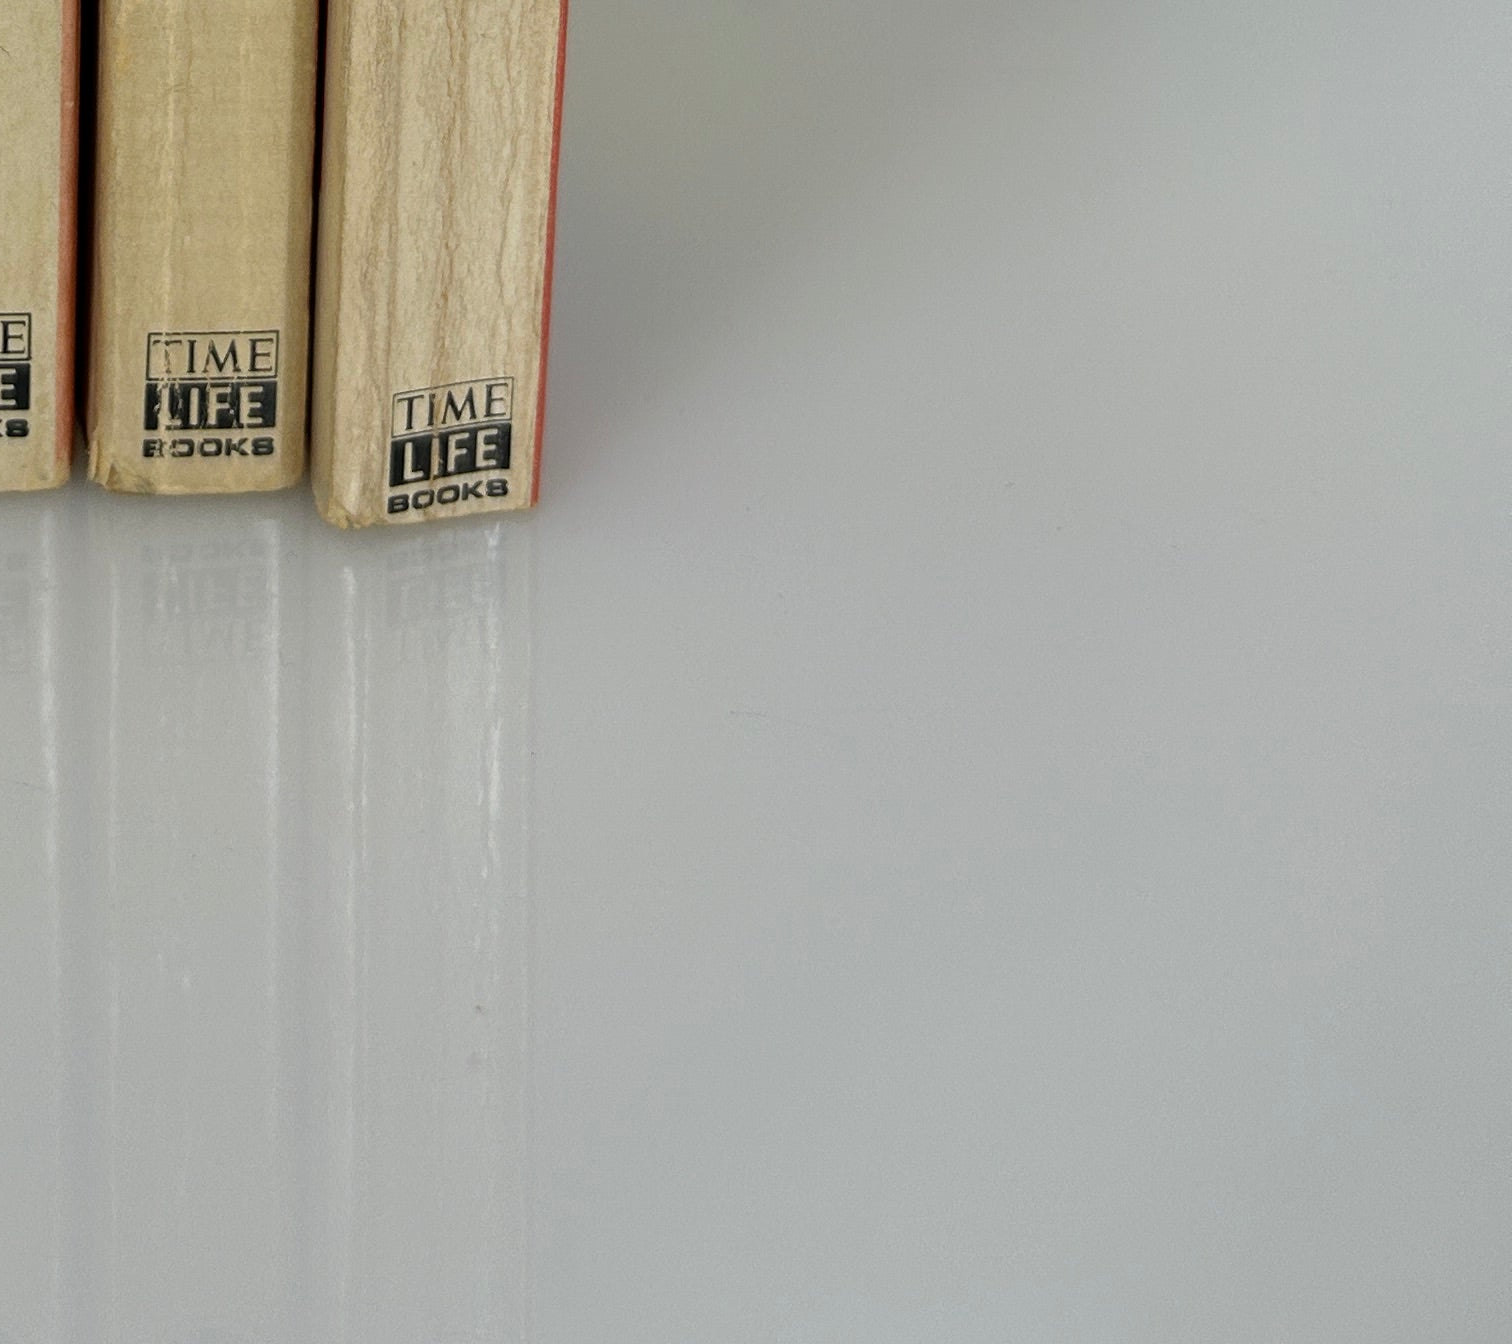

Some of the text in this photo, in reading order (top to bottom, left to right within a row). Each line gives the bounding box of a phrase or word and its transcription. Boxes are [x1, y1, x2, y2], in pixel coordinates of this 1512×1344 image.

[152, 338, 274, 373] TIME
[157, 386, 263, 427] LIFE
[397, 382, 509, 430] TIME
[403, 427, 499, 481] LIFE
[387, 478, 509, 514] BOOKS
